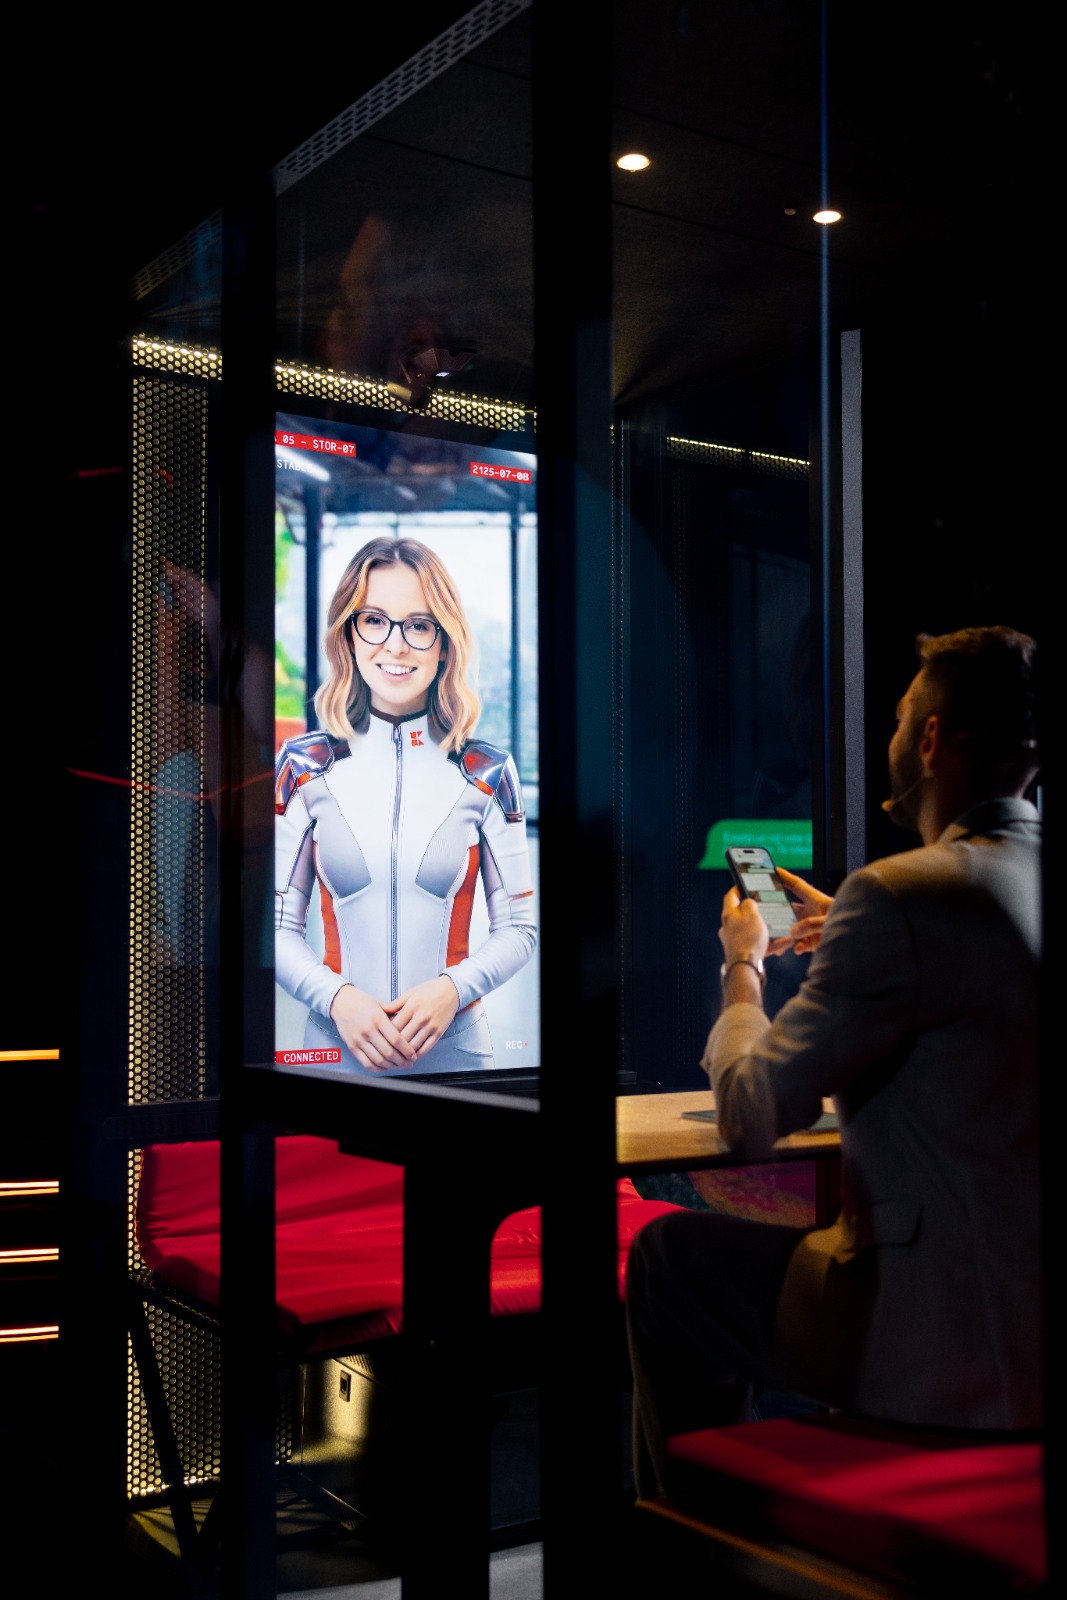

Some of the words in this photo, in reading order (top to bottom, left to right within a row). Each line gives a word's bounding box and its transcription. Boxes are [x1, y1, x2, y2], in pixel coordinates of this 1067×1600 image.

[282, 434, 295, 445] 05
[312, 439, 355, 454] STOR-07
[472, 465, 530, 481] 2125-07-08
[505, 1040, 522, 1050] REC
[284, 1051, 339, 1063] CONNECTED
